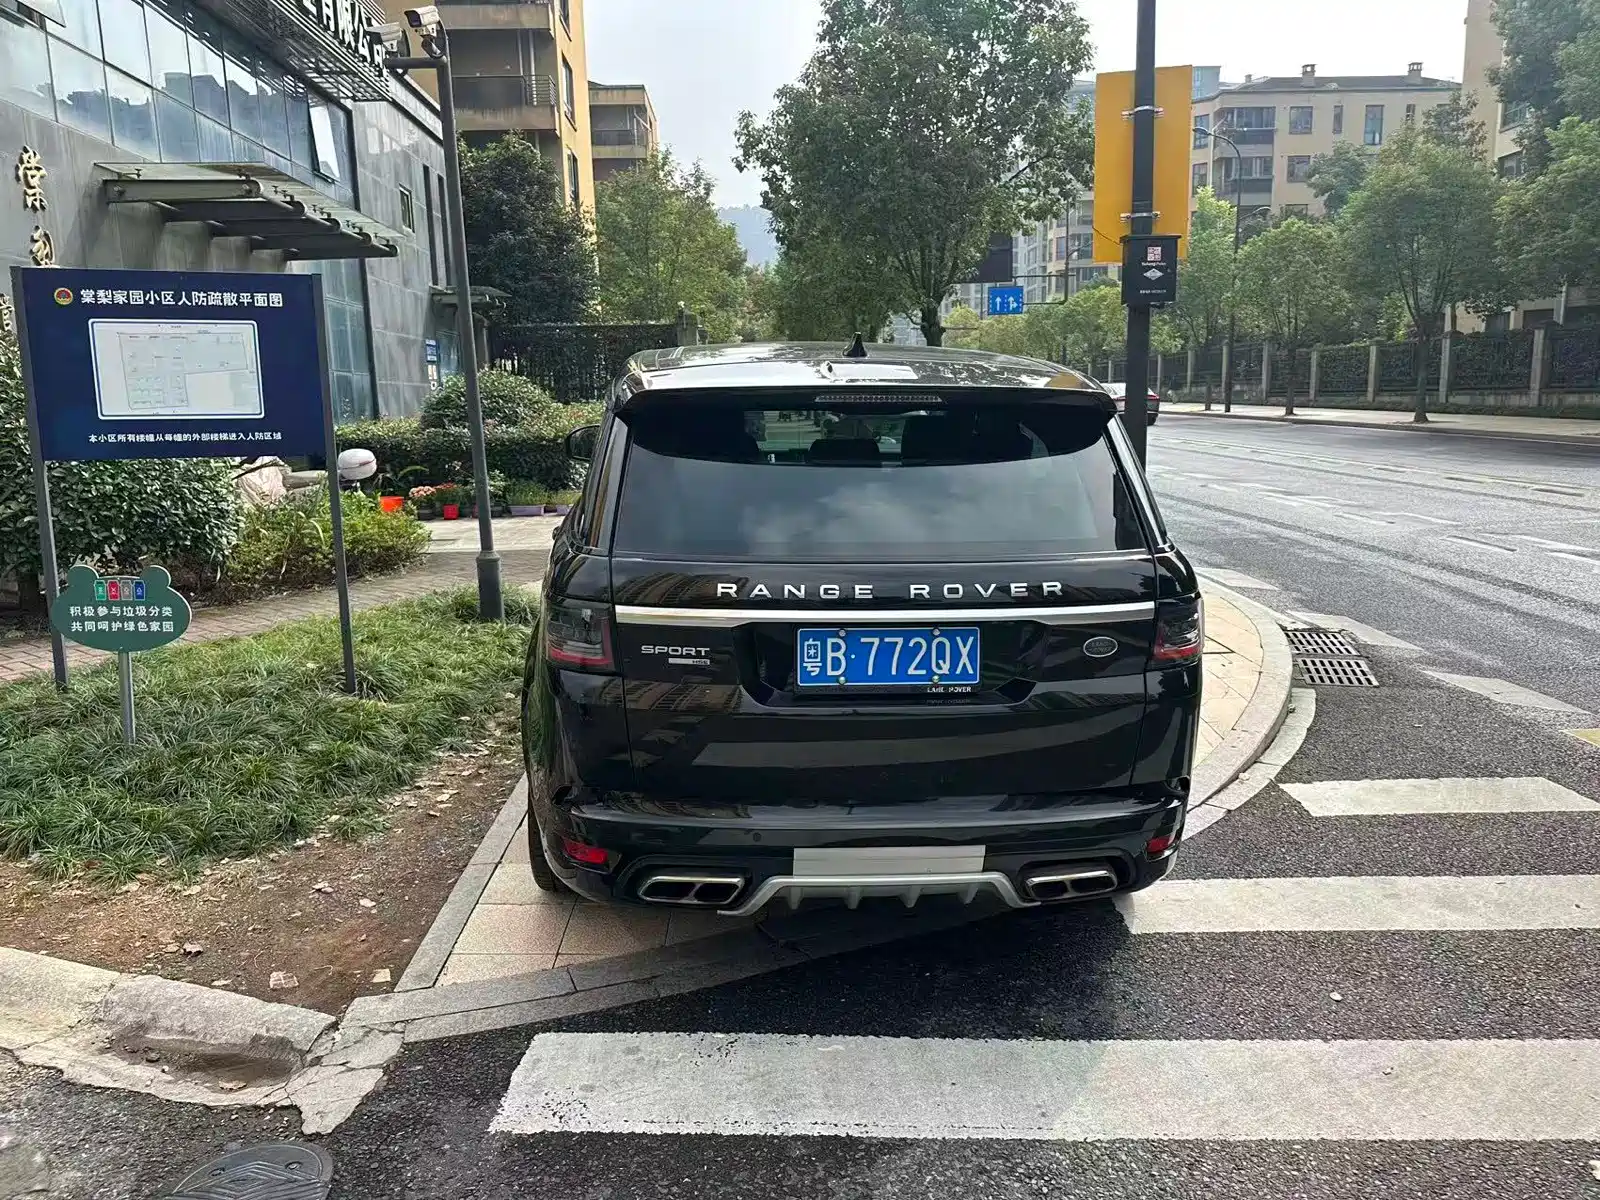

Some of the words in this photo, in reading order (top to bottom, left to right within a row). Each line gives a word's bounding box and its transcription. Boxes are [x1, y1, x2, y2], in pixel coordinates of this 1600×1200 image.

[80, 289, 283, 307] 棠梨家园小区人防疏散平面图
[717, 583, 873, 599] RANGE
[910, 581, 1062, 599] ROVER
[69, 605, 173, 617] 积极参与垃圾分类
[70, 621, 174, 632] 共同呵护绿色家园
[641, 645, 710, 656] SPORT
